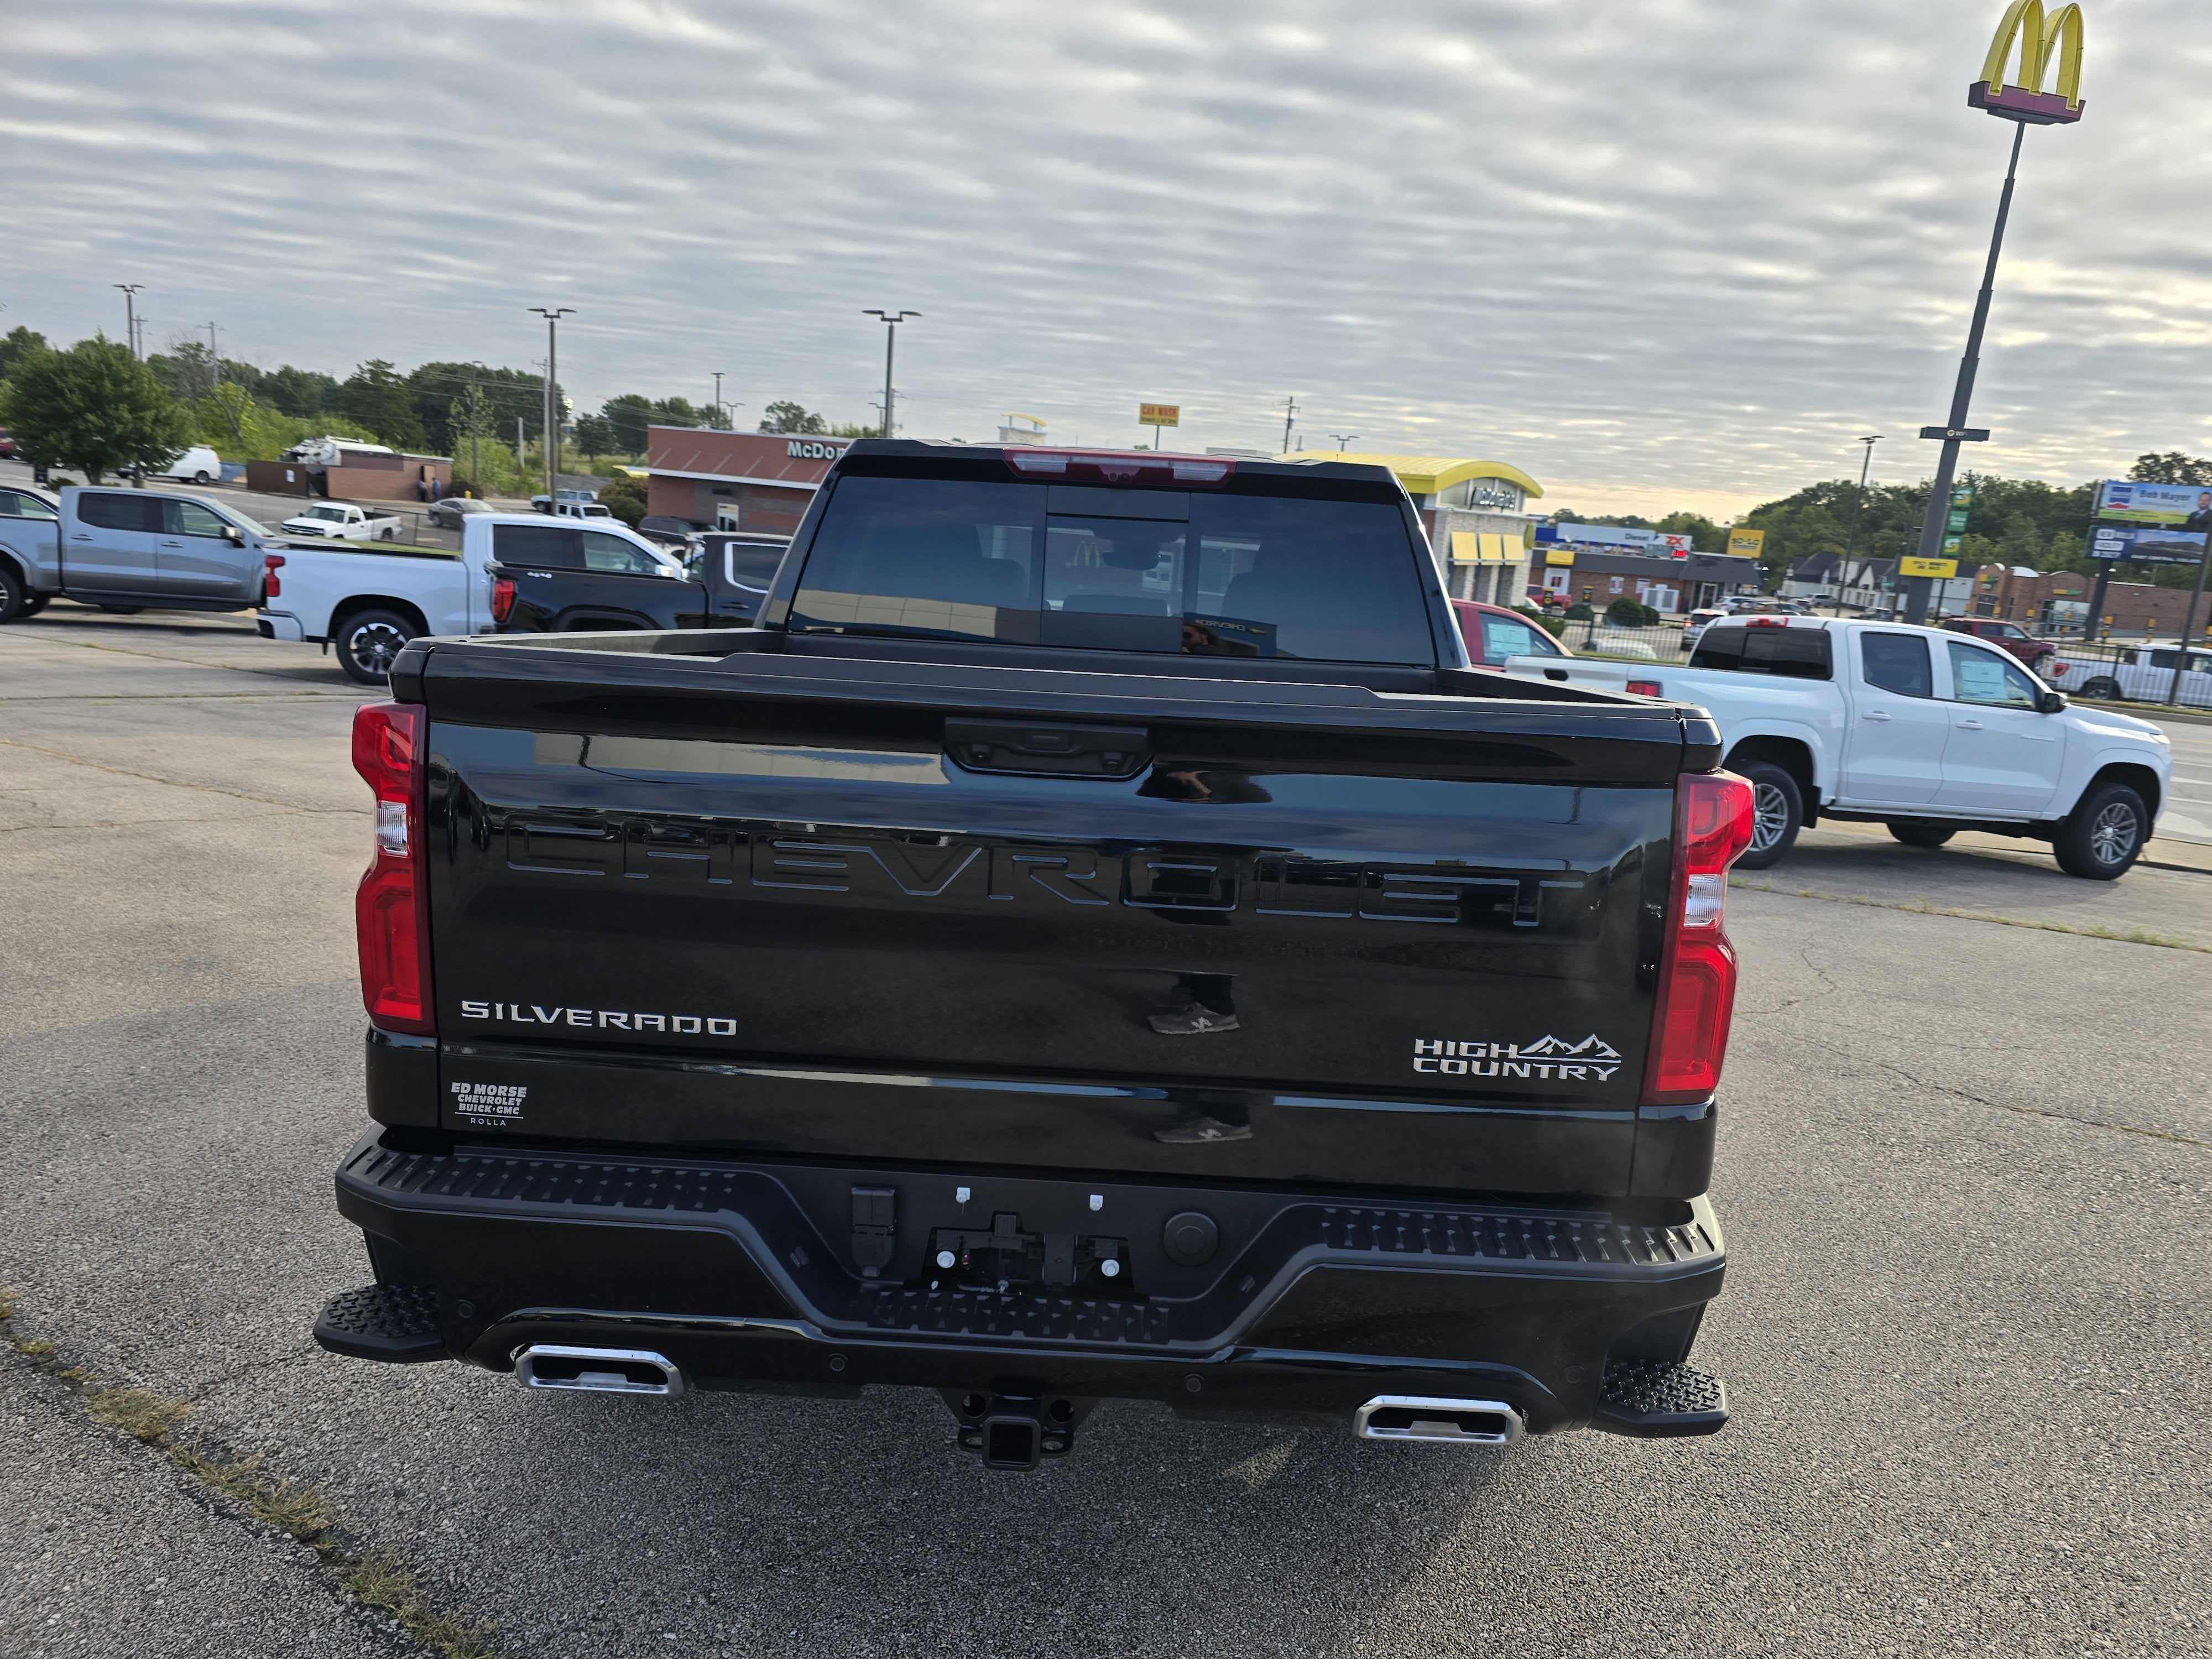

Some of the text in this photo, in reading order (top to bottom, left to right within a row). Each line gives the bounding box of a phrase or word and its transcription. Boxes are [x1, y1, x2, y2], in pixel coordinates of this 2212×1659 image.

[1142, 405, 1177, 416] CAR WASH
[2139, 490, 2157, 498] Bob
[2160, 492, 2191, 503] Mayer
[1625, 533, 1649, 541] Diesel
[506, 814, 1588, 928] CHEVROLET
[461, 1000, 737, 1036] SILVERADO
[1414, 1039, 1518, 1058] HIGH
[1413, 1057, 1619, 1081] COUNTRY
[451, 1082, 527, 1098] ED MORSE
[457, 1094, 523, 1106] CHEVROLET
[471, 1118, 506, 1126] ROLLA
